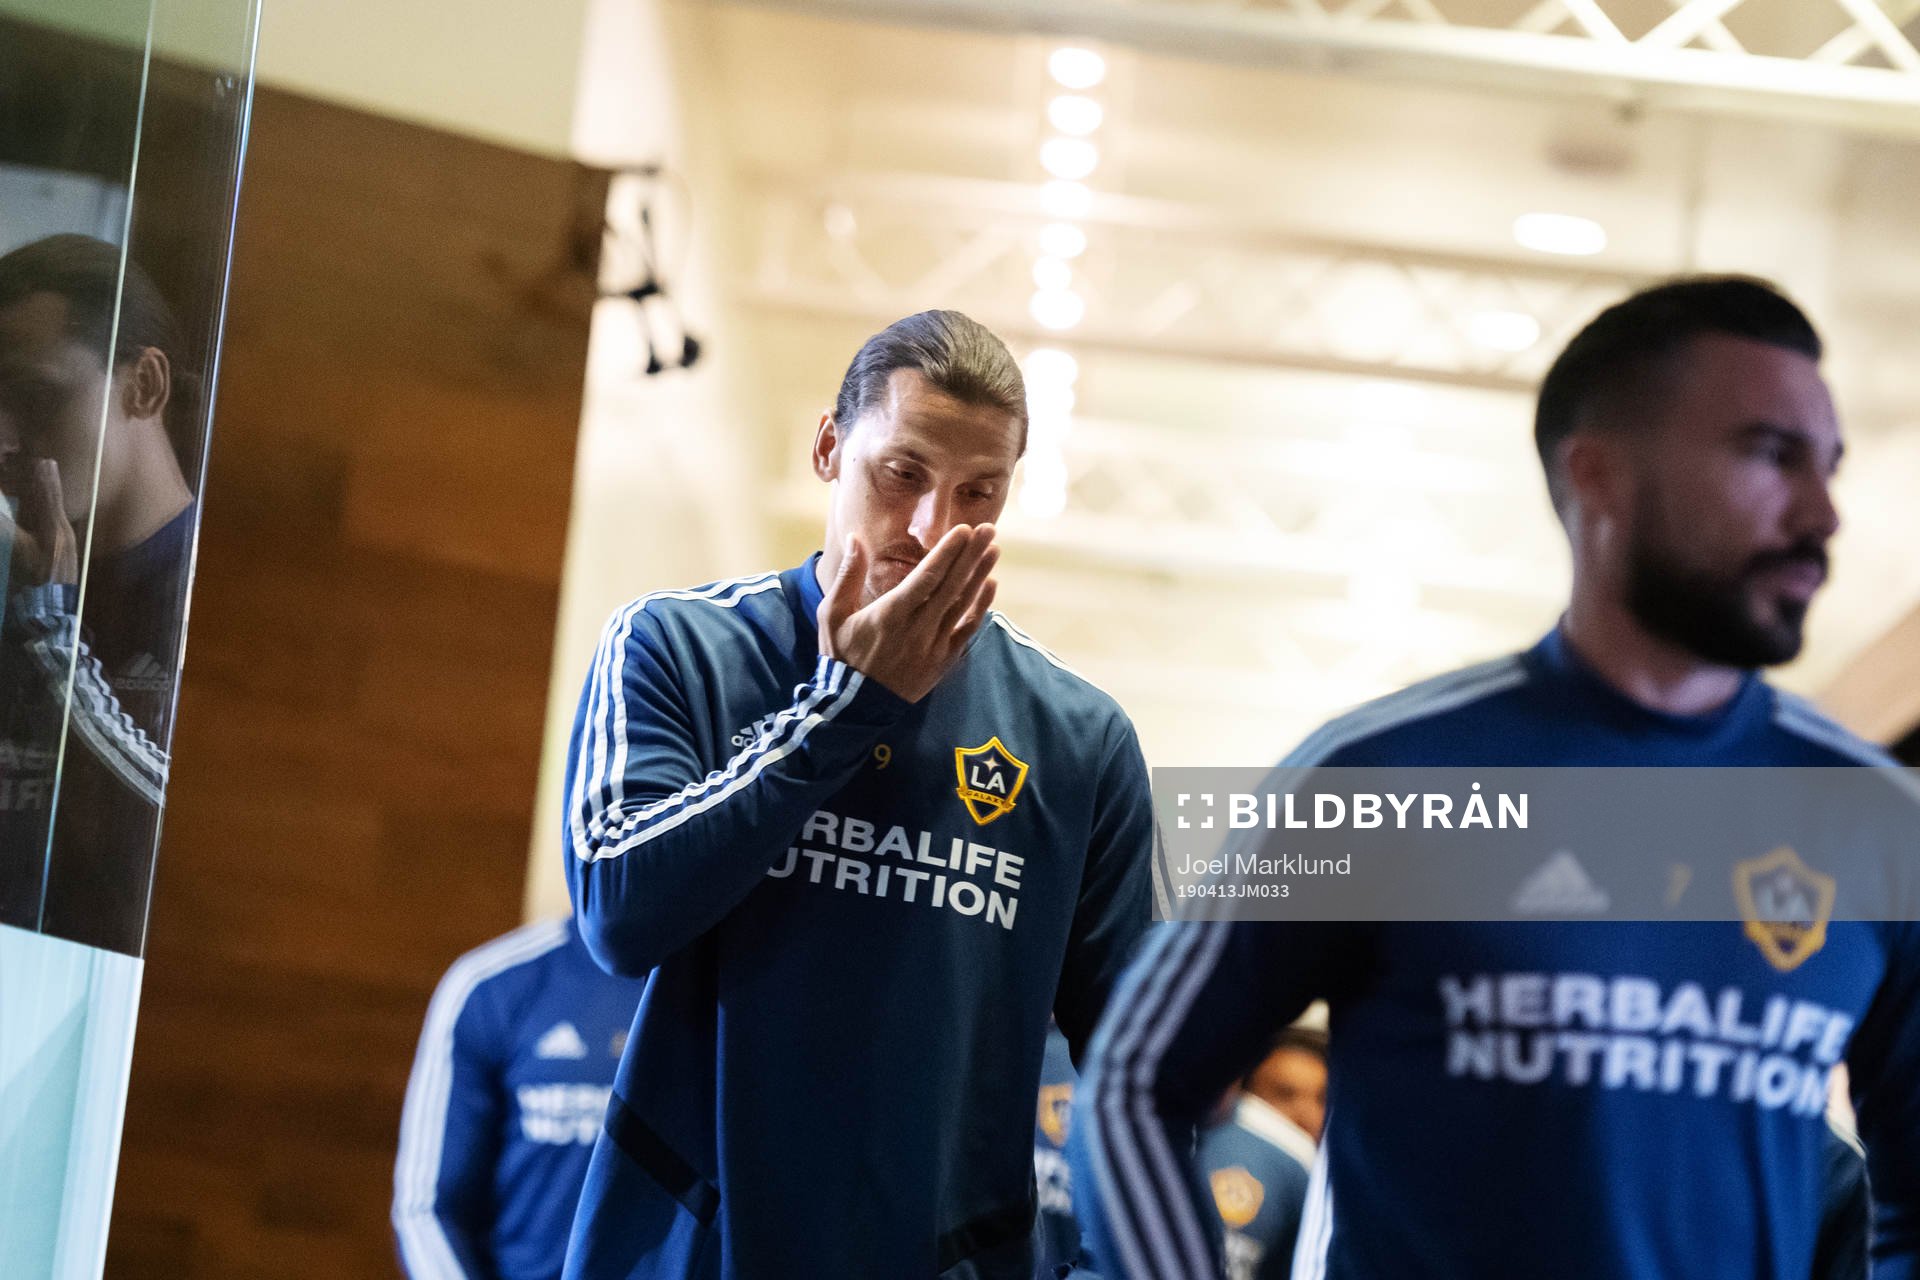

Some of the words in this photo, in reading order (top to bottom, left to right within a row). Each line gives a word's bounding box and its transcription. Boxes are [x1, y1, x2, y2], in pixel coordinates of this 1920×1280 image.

[874, 744, 892, 770] 9
[970, 765, 1006, 794] LA
[766, 846, 1019, 931] UTRITION
[802, 809, 1025, 890] RBALIFE
[1440, 971, 1855, 1064] HERBALIFE
[1446, 1030, 1833, 1118] NUTRITION
